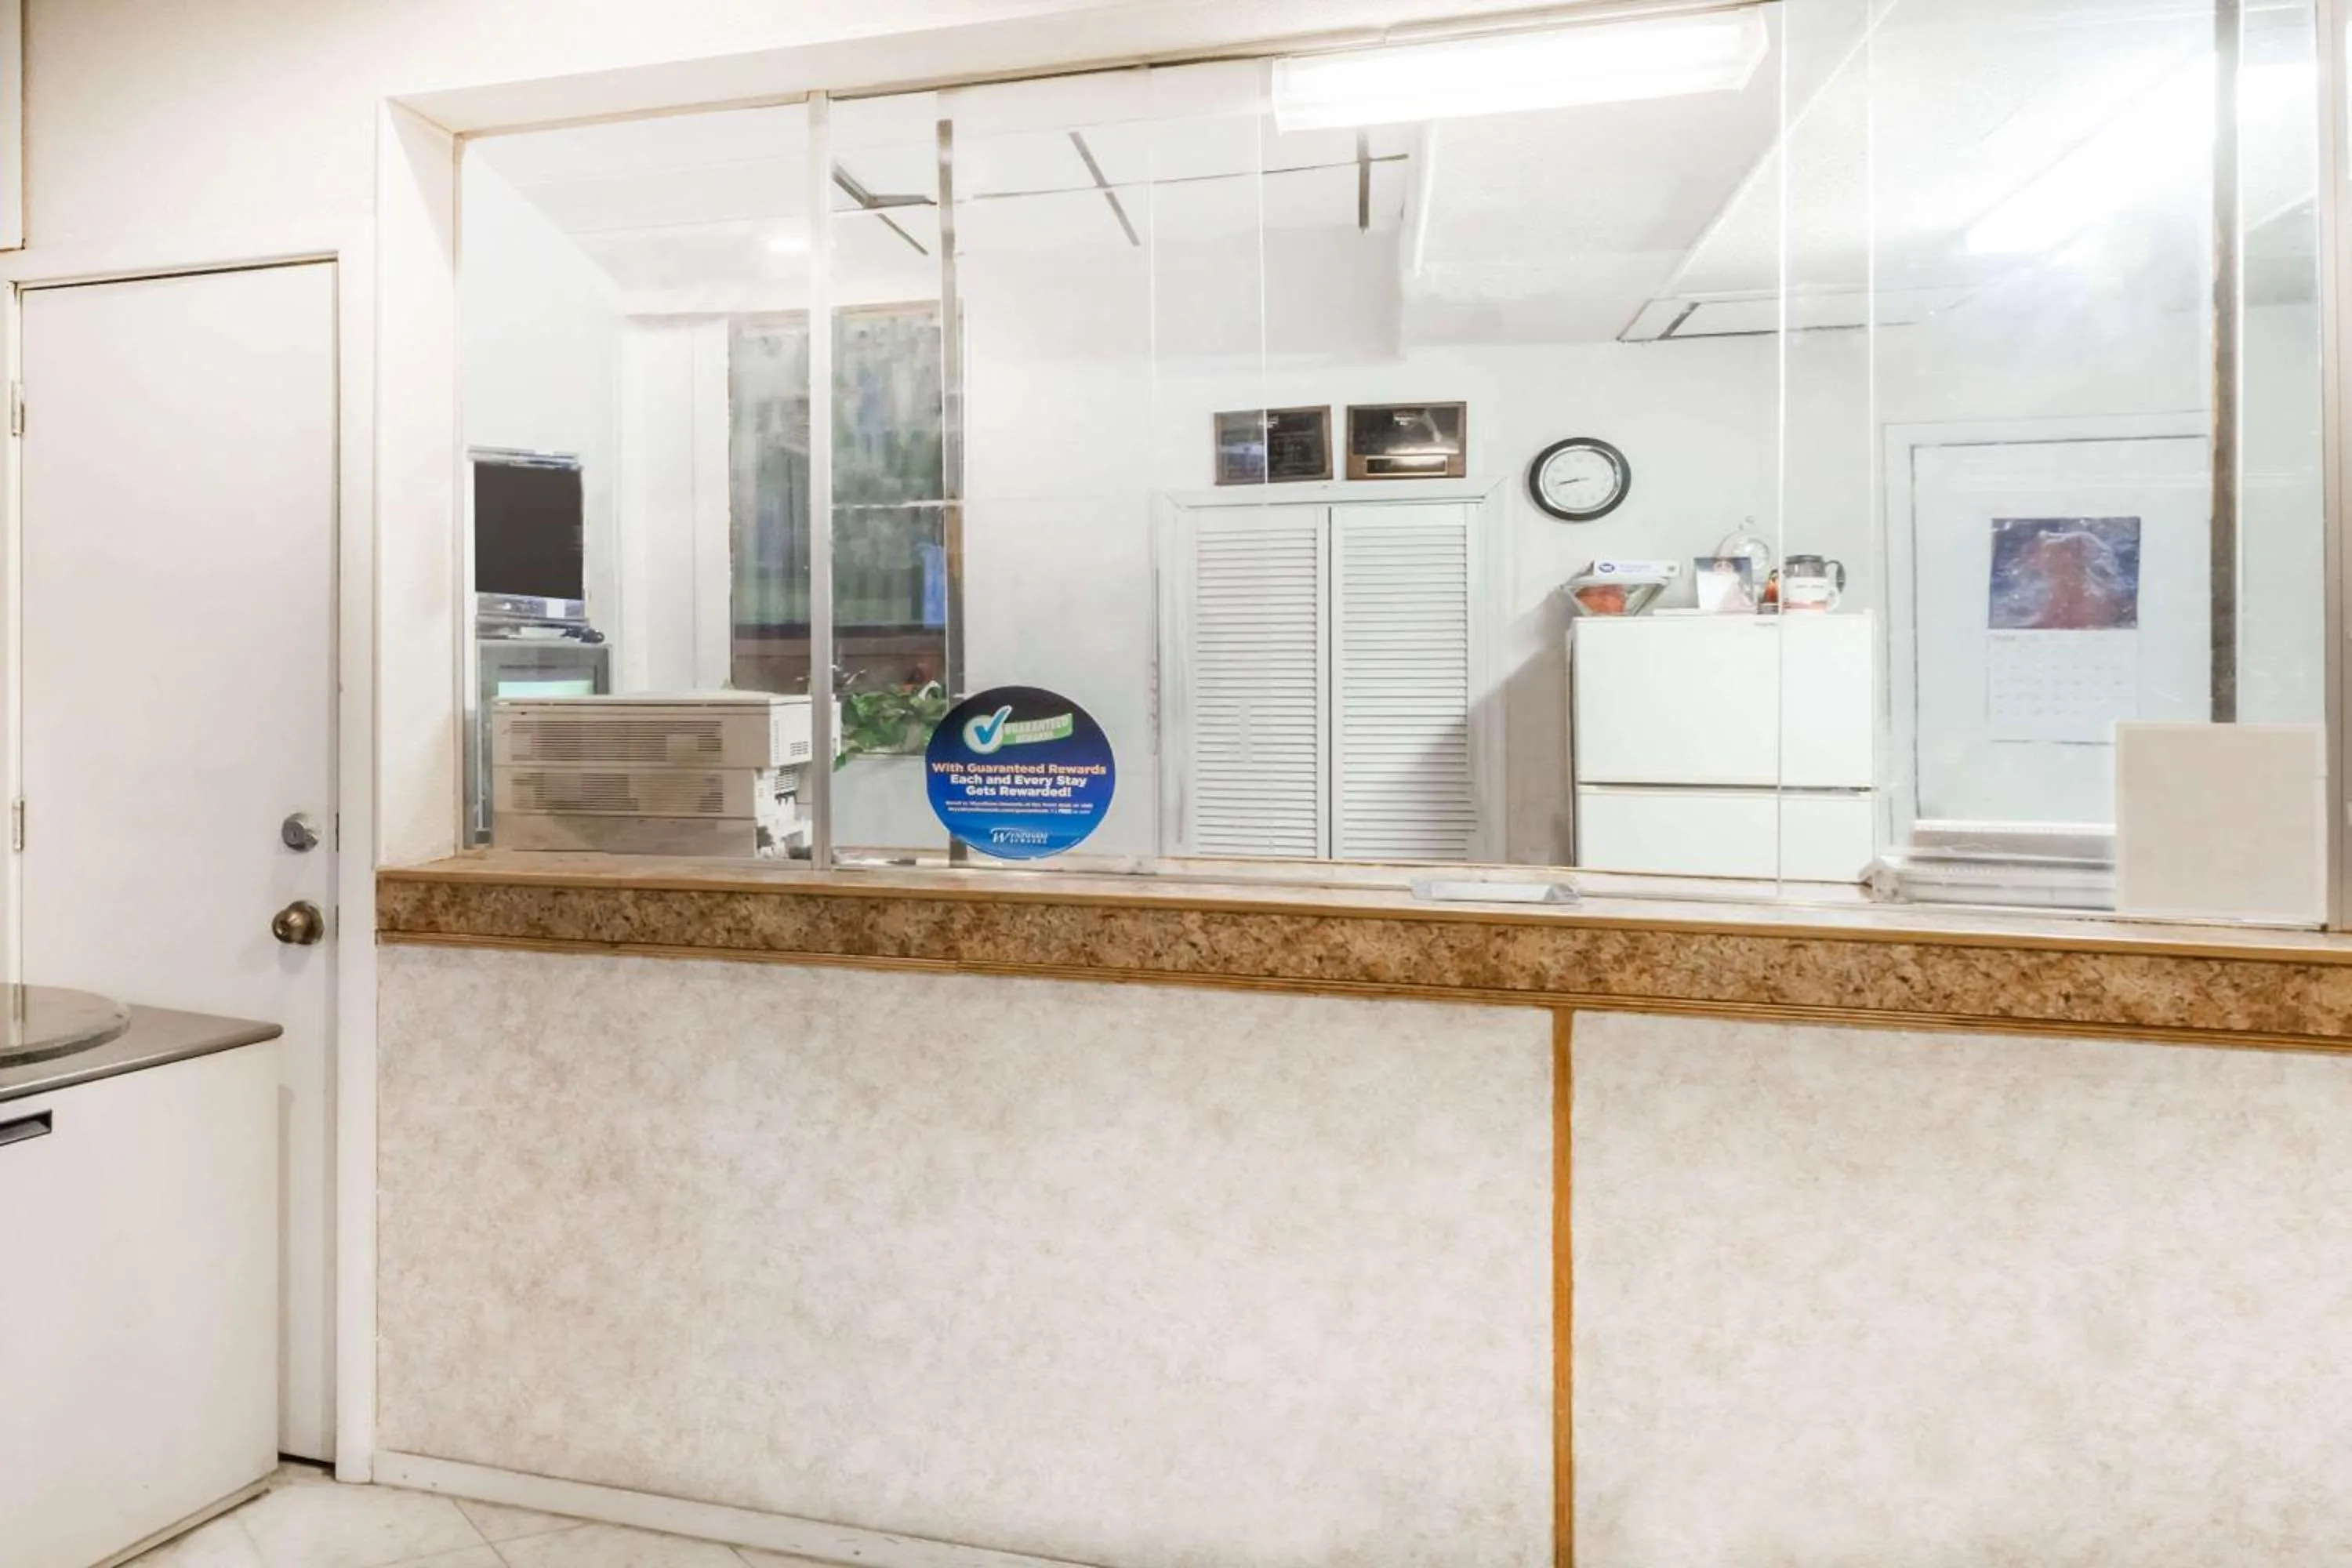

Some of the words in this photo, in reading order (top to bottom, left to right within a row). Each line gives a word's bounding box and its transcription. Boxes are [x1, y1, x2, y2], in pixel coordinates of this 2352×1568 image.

[931, 762, 964, 773] With
[967, 763, 1044, 774] Guaranteed
[1048, 764, 1106, 775] Rewards
[950, 774, 982, 785] Each
[985, 774, 1011, 785] and
[1014, 775, 1053, 788] Every
[1056, 775, 1087, 788] Stay
[965, 785, 996, 796] Gets
[999, 786, 1072, 797] Rewarded!
